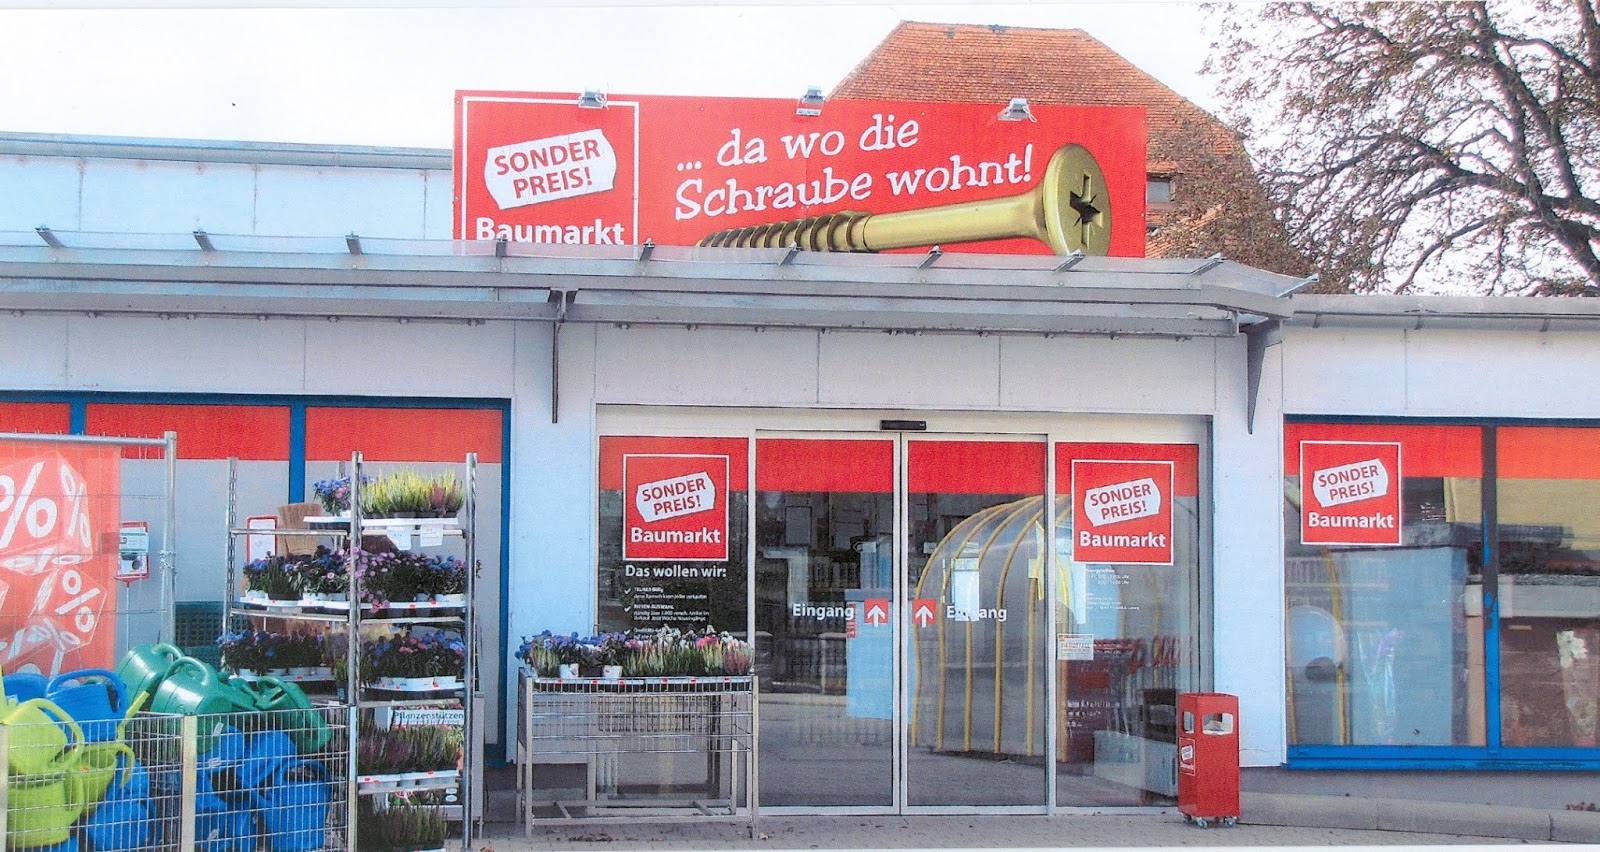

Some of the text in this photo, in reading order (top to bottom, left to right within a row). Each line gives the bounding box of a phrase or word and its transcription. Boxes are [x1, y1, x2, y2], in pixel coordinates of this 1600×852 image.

[716, 128, 768, 167] da
[780, 130, 846, 160] wo
[859, 113, 919, 151] die
[494, 138, 601, 176] SONDER
[513, 166, 593, 199] PREIS!
[675, 143, 1033, 221] Schraube wohnt!
[476, 217, 625, 245] Baumarkt
[1318, 465, 1379, 488] SONDER
[642, 478, 706, 502] SONDER
[1090, 483, 1152, 507] SONDER
[1329, 481, 1375, 501] PREIS!
[653, 495, 701, 516] PREIS!
[1101, 500, 1147, 520] PREIS!
[1308, 511, 1395, 528] Baumarkt
[631, 526, 721, 544] Baumarkt
[1080, 530, 1166, 548] Baumarkt
[625, 564, 727, 578] Das wollen wir:
[793, 603, 855, 620] Eingang
